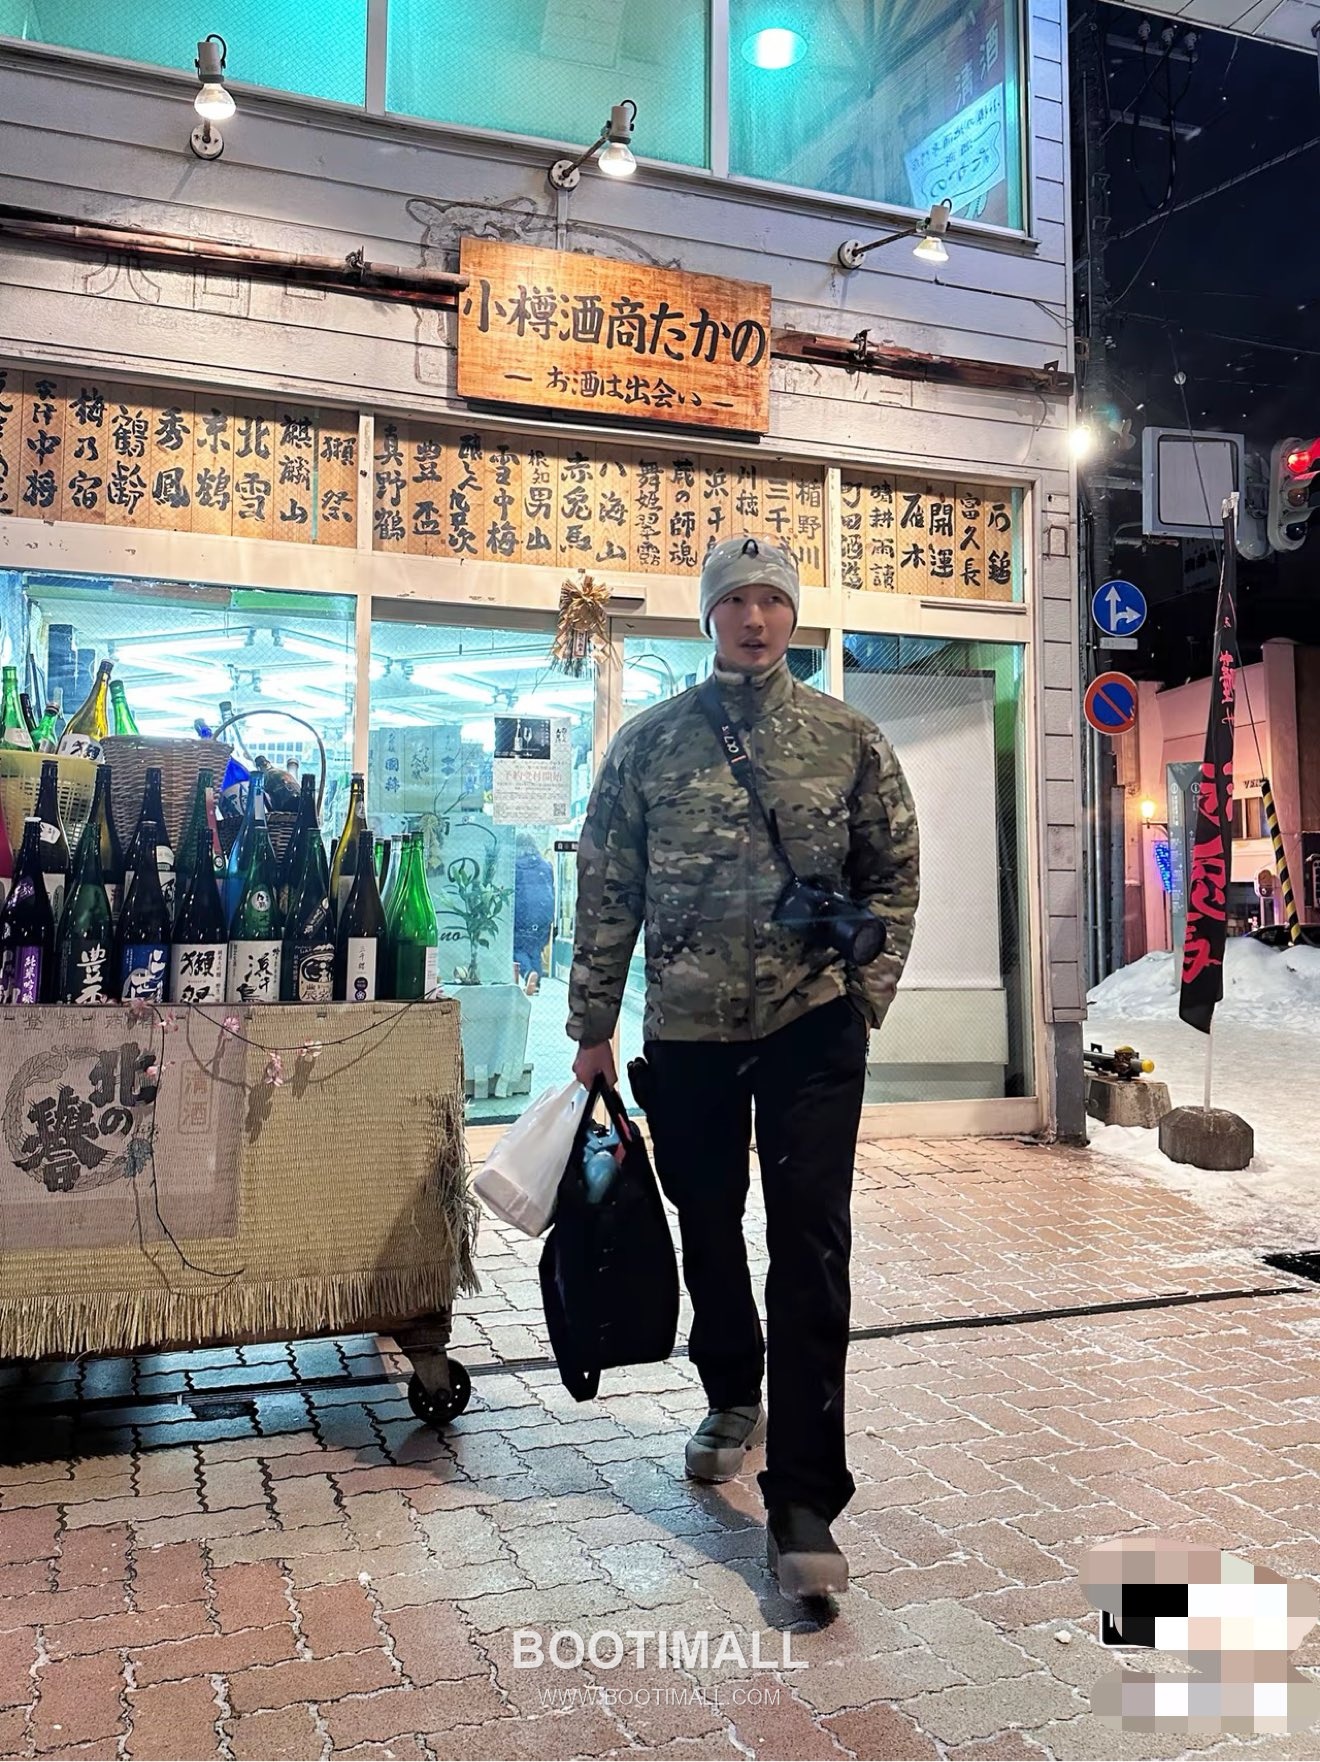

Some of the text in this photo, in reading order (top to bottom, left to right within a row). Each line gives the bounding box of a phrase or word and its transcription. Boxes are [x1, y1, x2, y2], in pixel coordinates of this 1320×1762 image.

[463, 279, 766, 367] 小樽酒商たかの
[69, 387, 108, 509] 梅乃宿
[152, 406, 190, 508] 秀鳳
[235, 416, 271, 522] 北雪
[374, 424, 406, 541] 真野鶴
[486, 444, 520, 556] 雪中梅
[524, 449, 552, 551] 根知男山
[596, 461, 628, 562] 八海山
[669, 459, 697, 567] 蔵の師魂
[765, 479, 799, 560] 三千
[928, 503, 954, 578] 開運
[960, 492, 981, 586] 富久長
